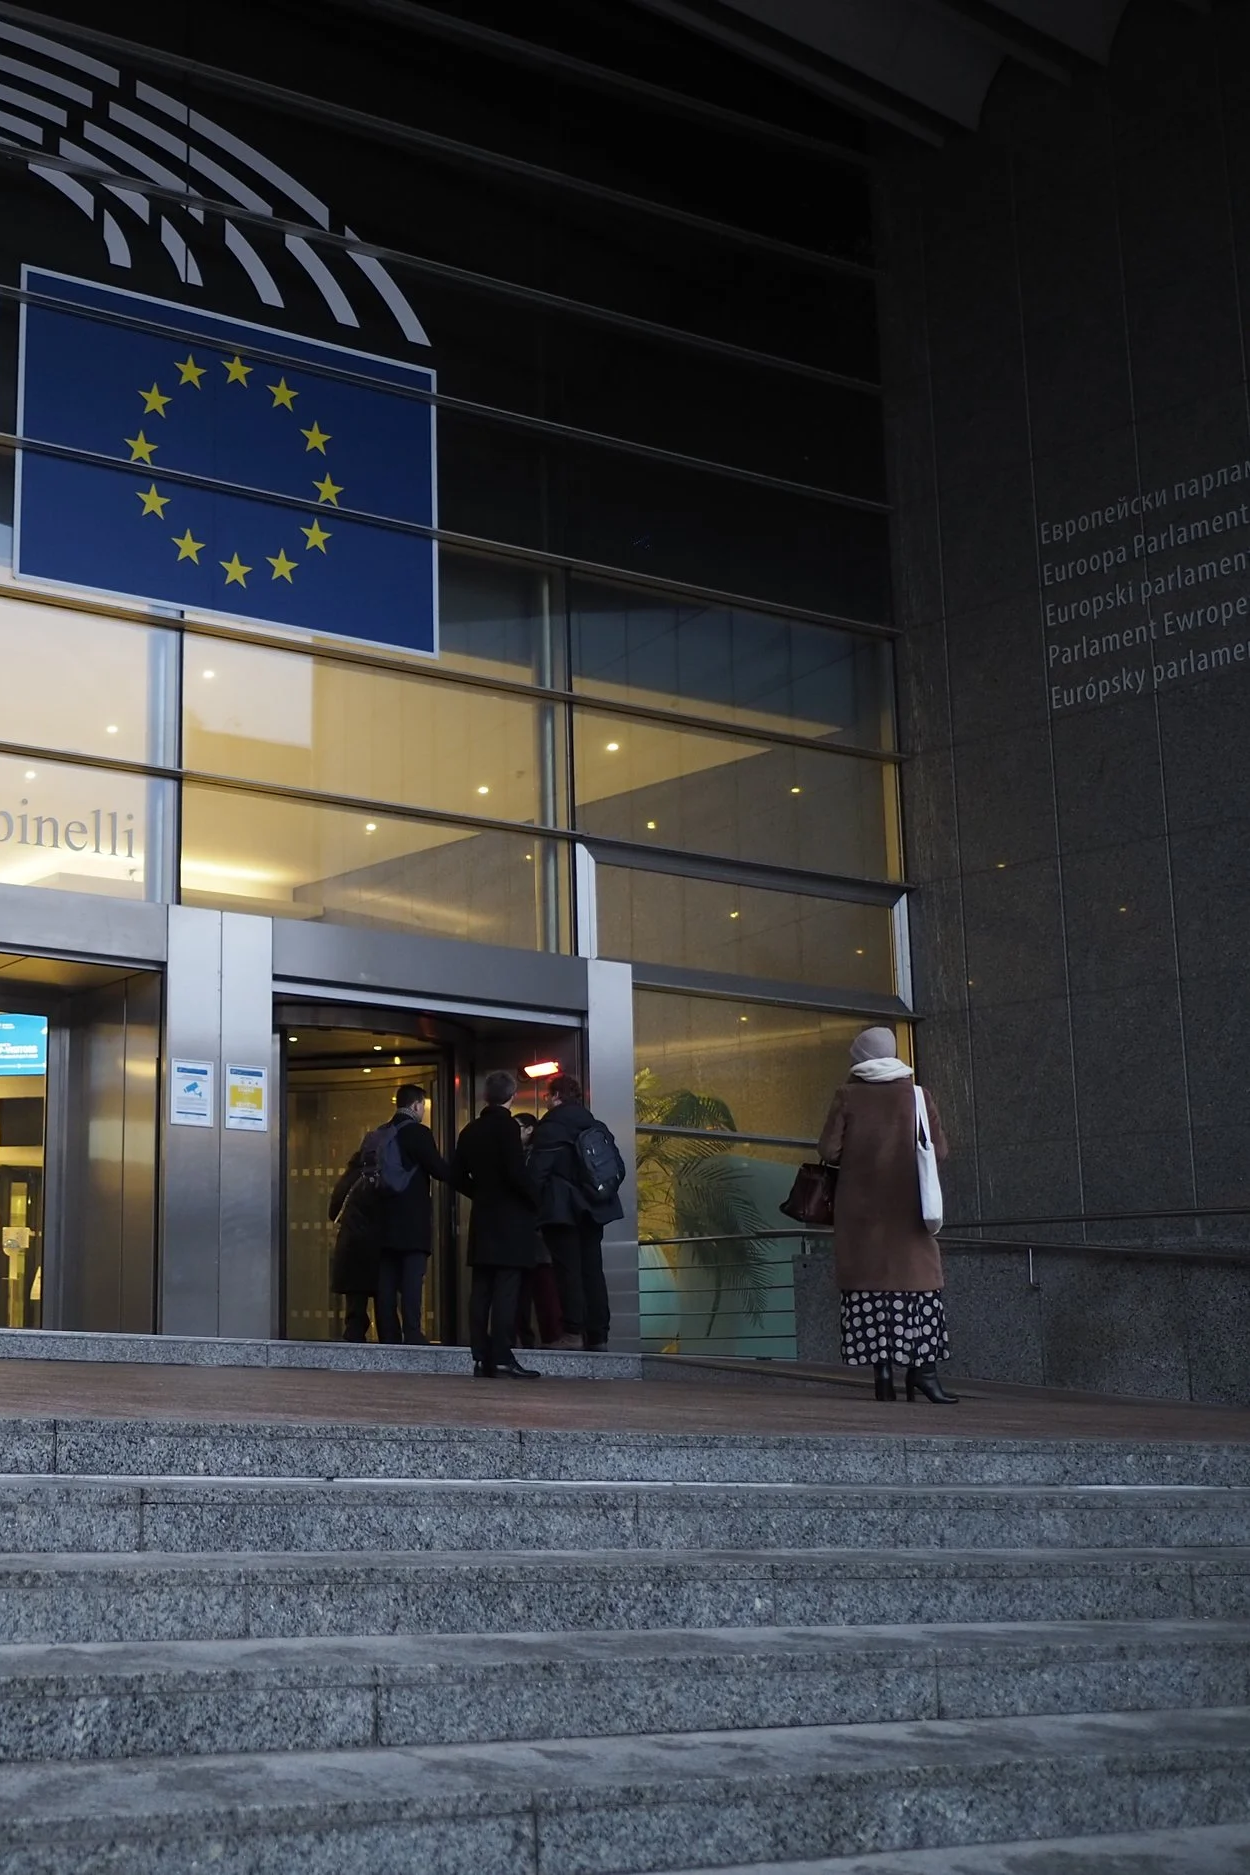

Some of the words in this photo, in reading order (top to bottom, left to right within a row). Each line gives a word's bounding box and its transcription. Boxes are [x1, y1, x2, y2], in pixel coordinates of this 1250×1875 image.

[1040, 487, 1167, 545] Европейски
[1043, 546, 1127, 586] Euroopa
[1133, 504, 1249, 558] Parlament
[1046, 580, 1133, 627] Europski
[1140, 549, 1250, 605] parlamen
[1049, 619, 1157, 668] Parlament
[1164, 594, 1250, 636] Ewrope
[1051, 667, 1146, 710] Európsky
[1153, 641, 1250, 689] parlame
